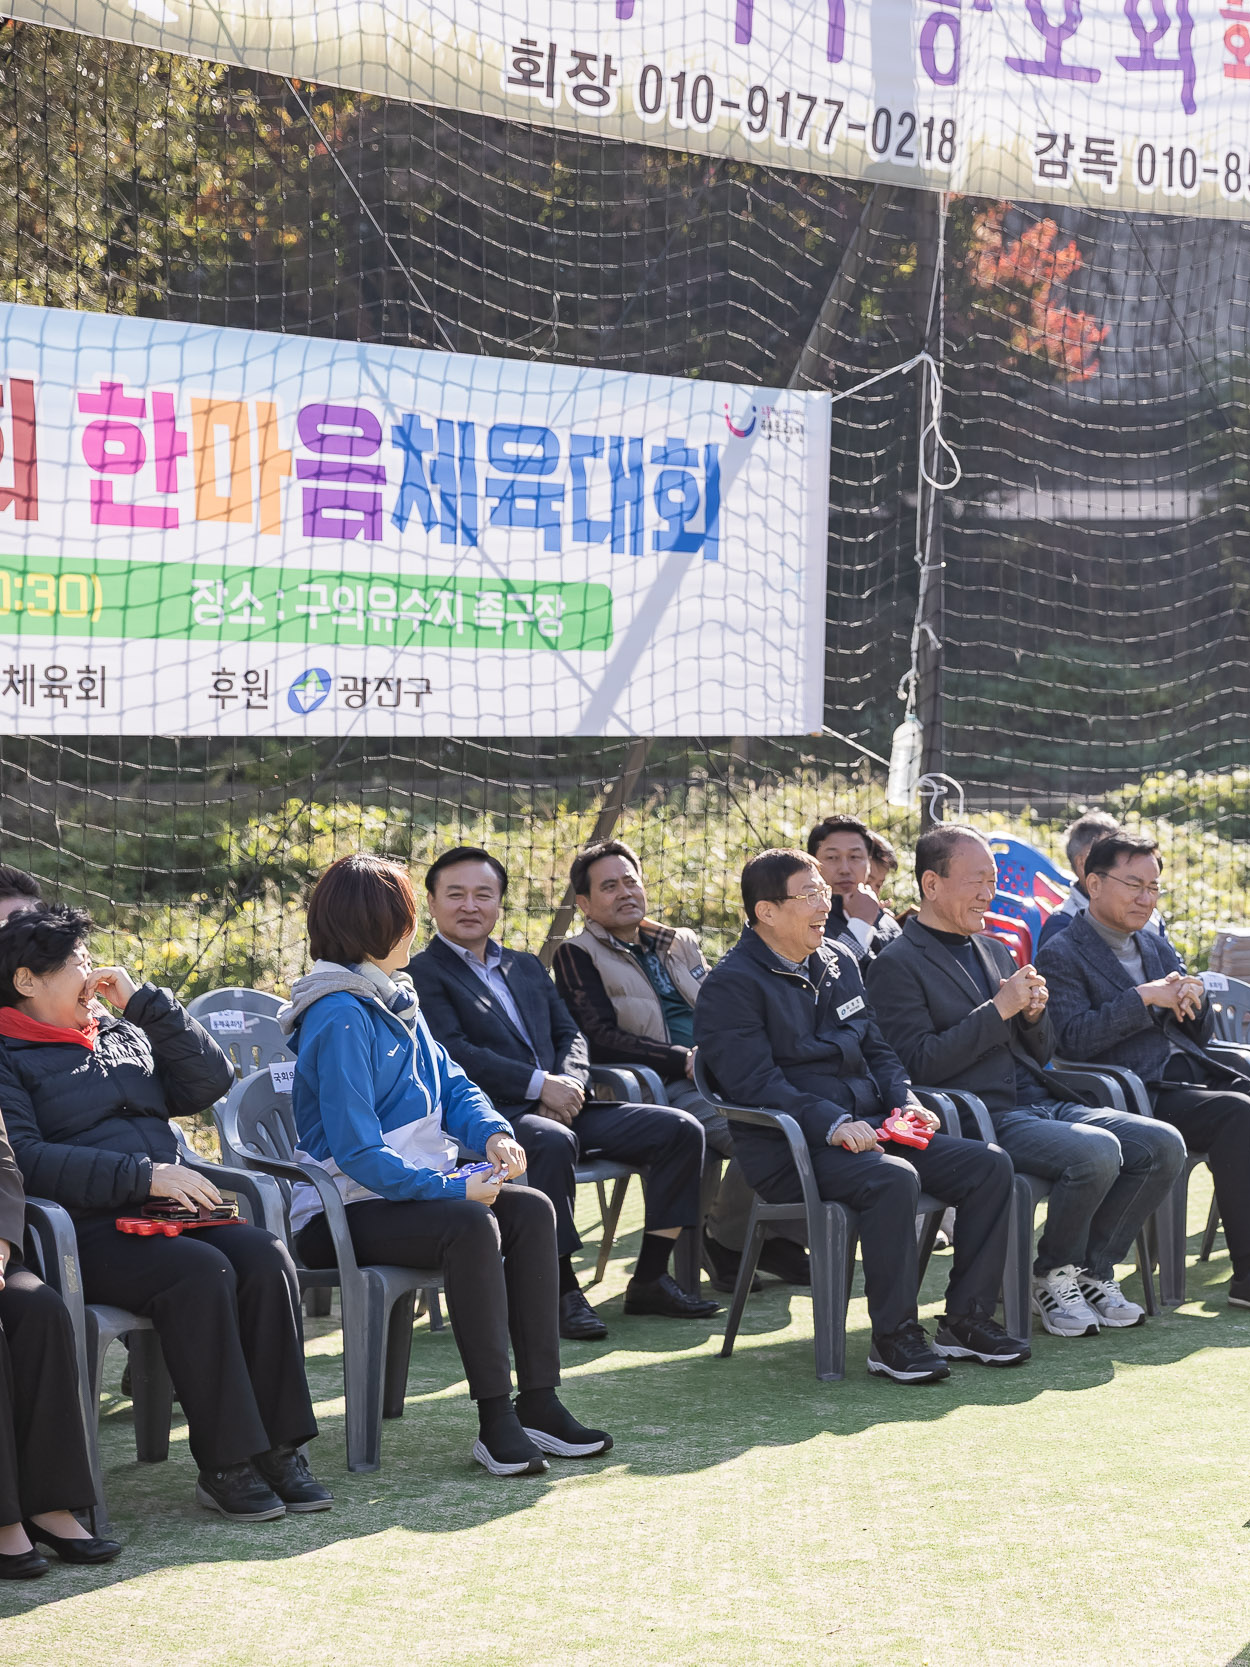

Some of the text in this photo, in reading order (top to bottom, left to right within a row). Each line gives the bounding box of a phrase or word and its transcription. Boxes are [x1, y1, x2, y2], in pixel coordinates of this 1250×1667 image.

[507, 38, 957, 164] 회장 010-9177-0218
[1034, 132, 1118, 185] 감독
[77, 381, 720, 561] 한마음체육대회
[191, 579, 266, 626] 장소
[295, 584, 463, 634] 구의유수지
[473, 590, 567, 637] 족구장
[208, 666, 270, 710] 후원
[338, 676, 433, 710] 광진구
